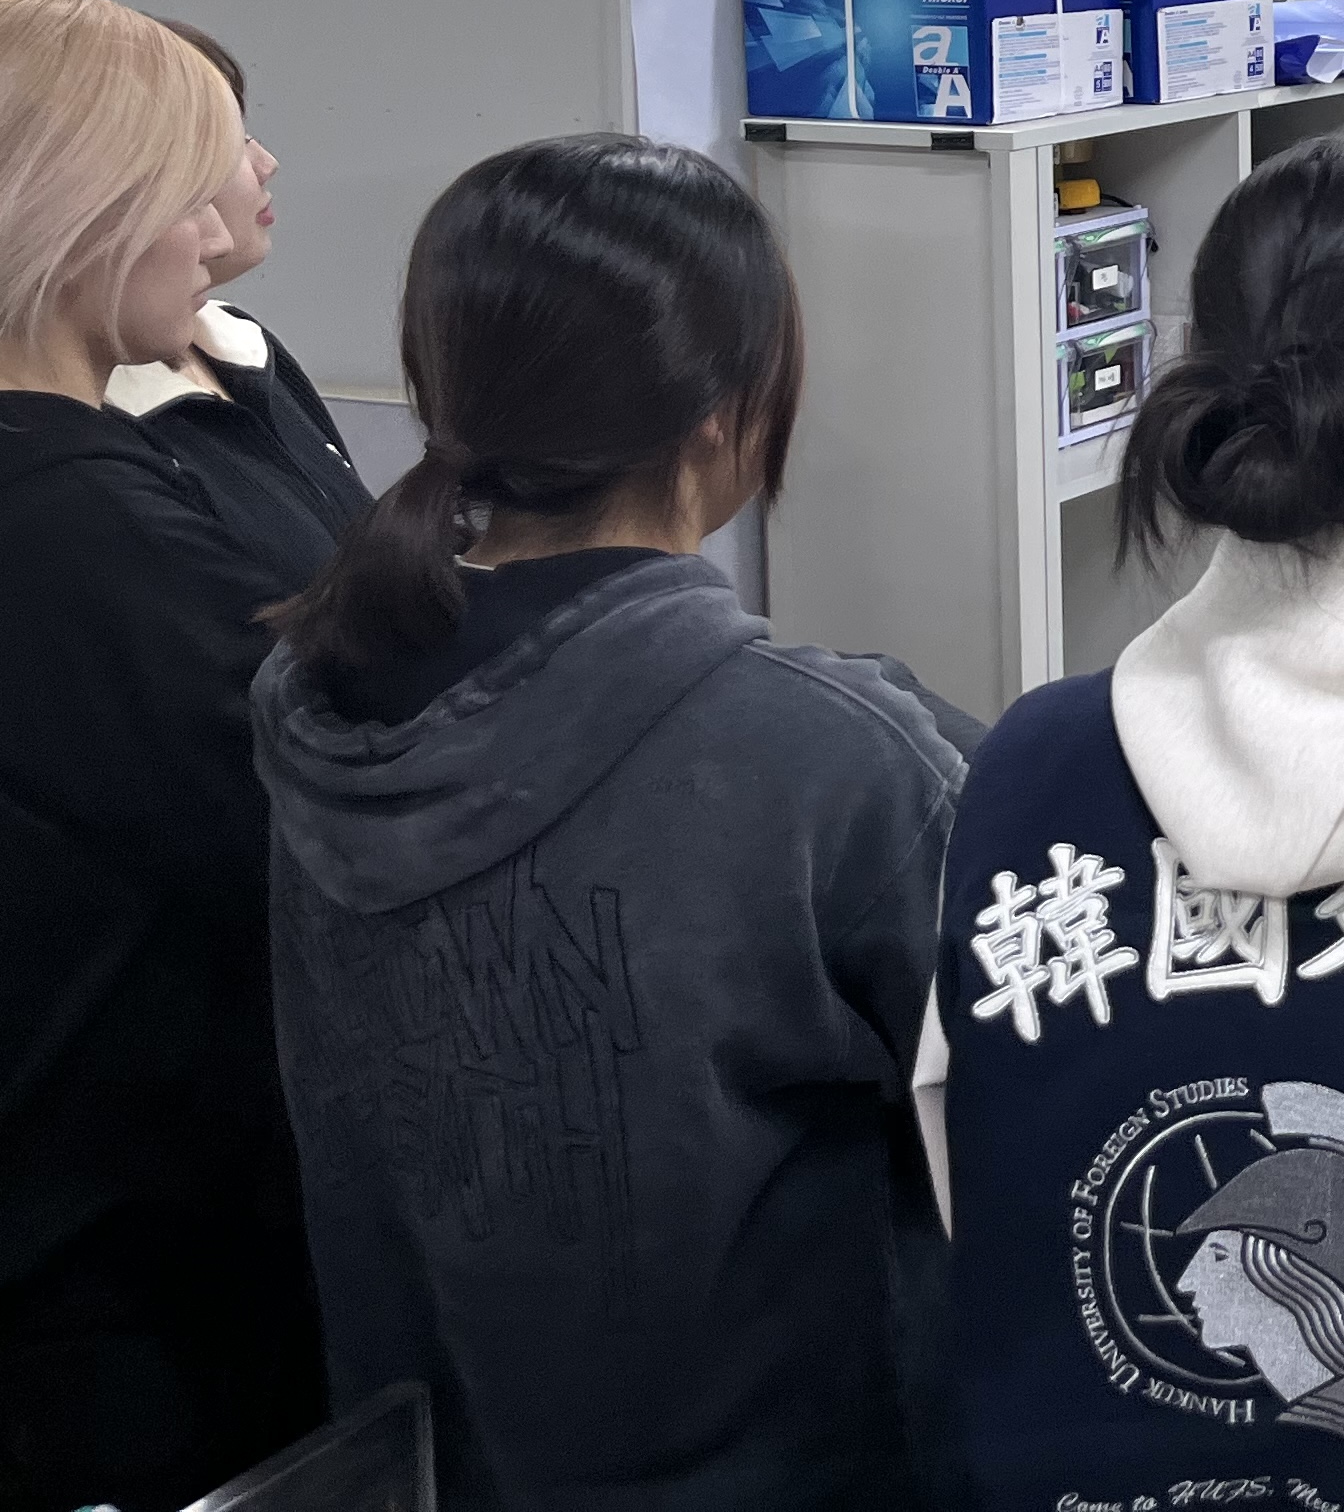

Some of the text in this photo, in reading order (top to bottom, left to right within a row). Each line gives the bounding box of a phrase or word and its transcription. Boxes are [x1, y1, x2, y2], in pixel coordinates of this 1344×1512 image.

[1070, 1076, 1255, 1425] HANKUK UNIVERSITY OF FOREIGN STUDIES
